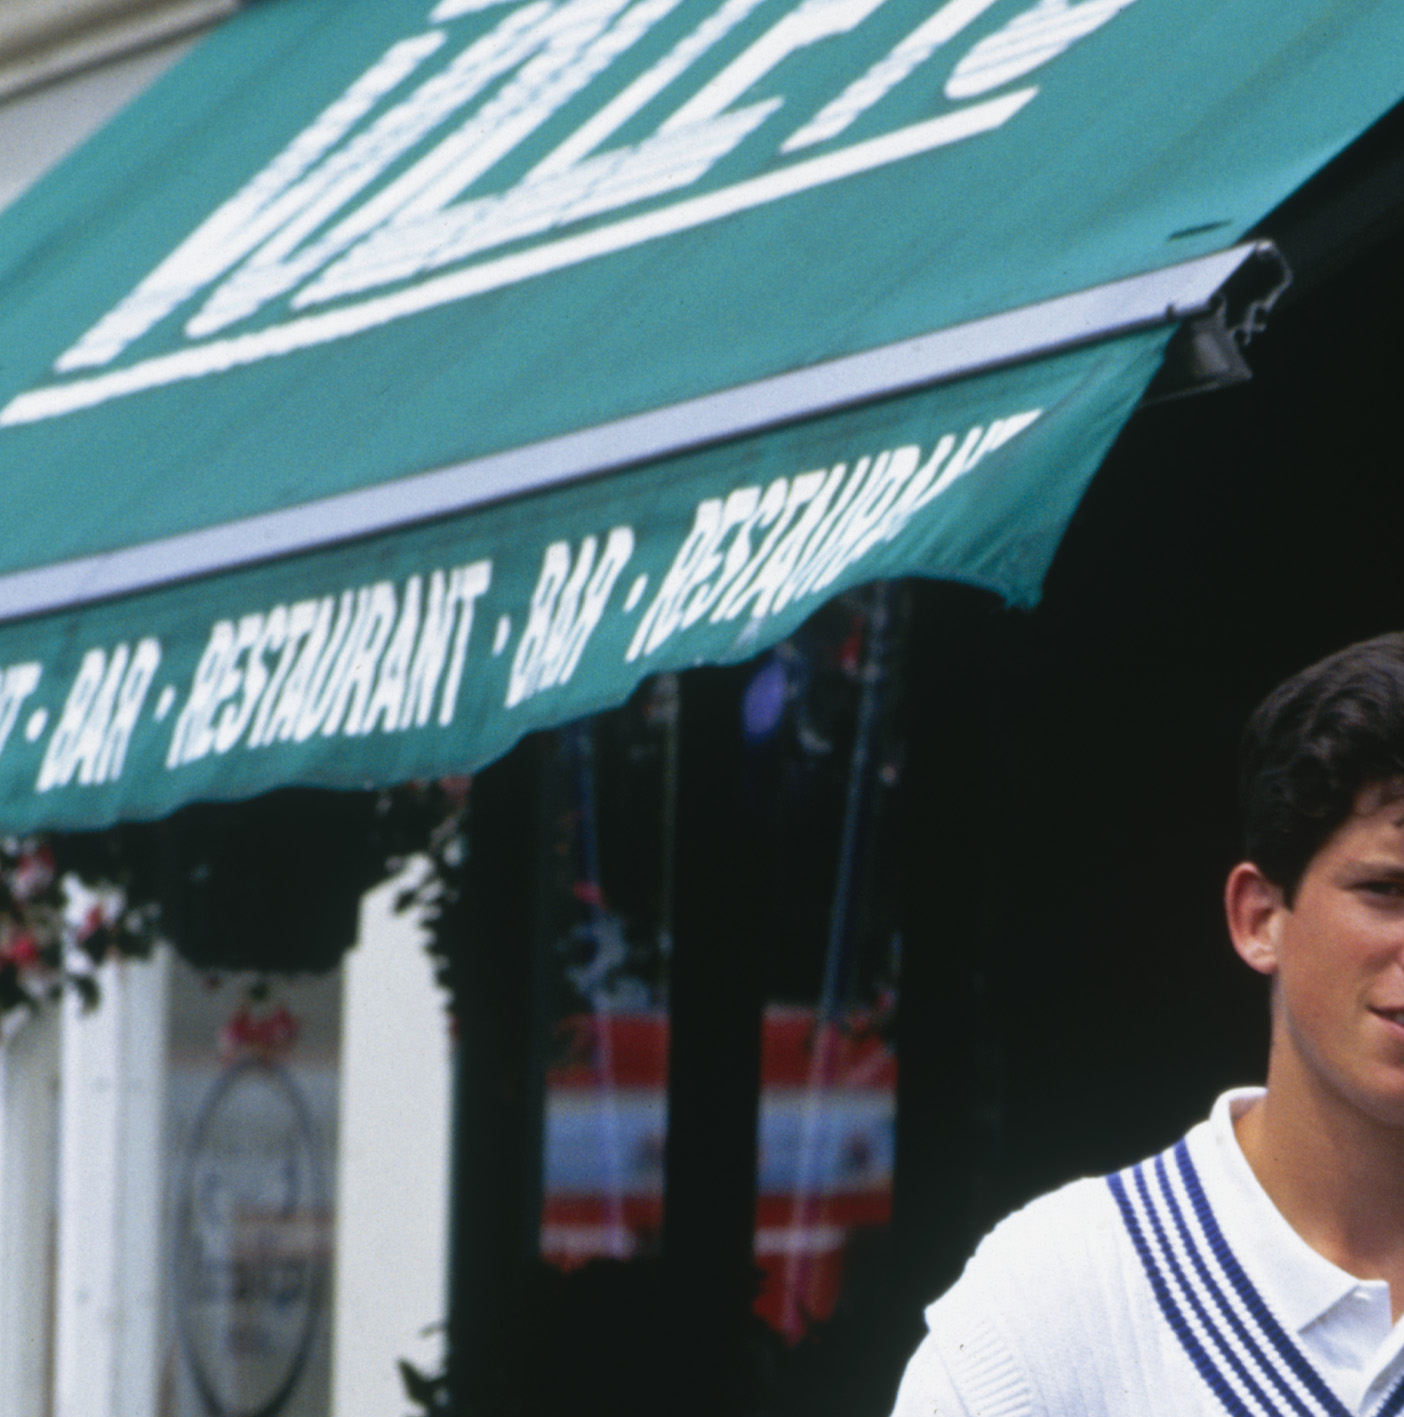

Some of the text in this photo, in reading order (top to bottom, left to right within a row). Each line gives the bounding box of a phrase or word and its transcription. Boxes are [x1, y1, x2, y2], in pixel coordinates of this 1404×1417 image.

[36, 636, 162, 793] BAR
[165, 558, 493, 770] RESTAURANT
[504, 525, 635, 709] BAR
